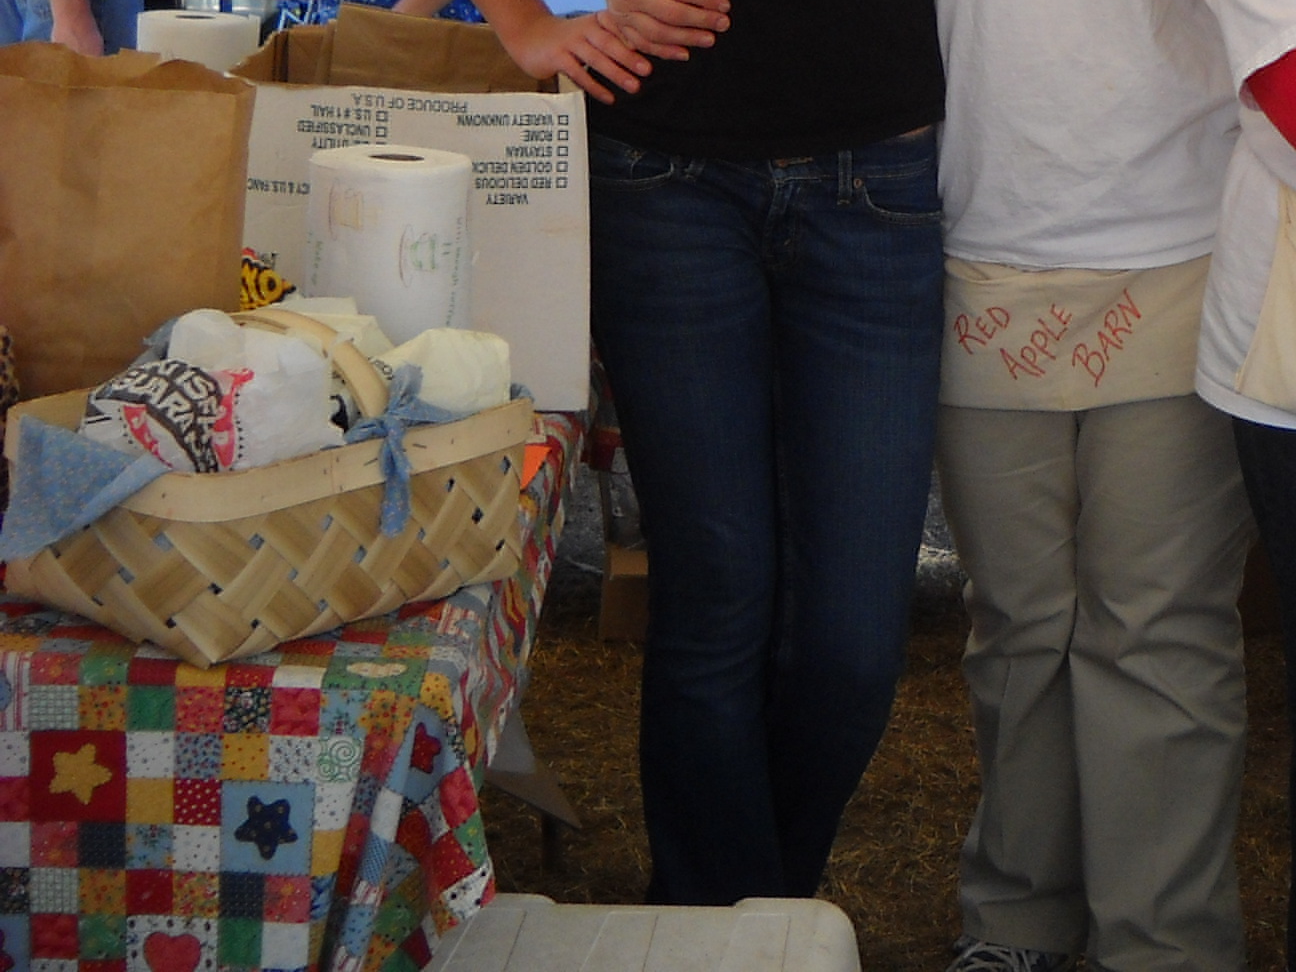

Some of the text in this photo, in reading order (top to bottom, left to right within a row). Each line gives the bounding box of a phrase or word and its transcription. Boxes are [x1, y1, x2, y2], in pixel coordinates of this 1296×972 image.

[388, 97, 405, 110] OF
[407, 97, 468, 113] PRODUCE
[456, 114, 553, 126] VARIETY UNKNOWN
[297, 120, 371, 137] UNCLASSIFIED
[521, 130, 552, 142] ROME
[506, 146, 552, 157] STAYMAN
[510, 161, 552, 173] GOLDEN
[475, 177, 552, 189] RED DELICIOUS
[486, 193, 529, 205] VARIETY
[953, 288, 1142, 388] RED APPLE BARN
